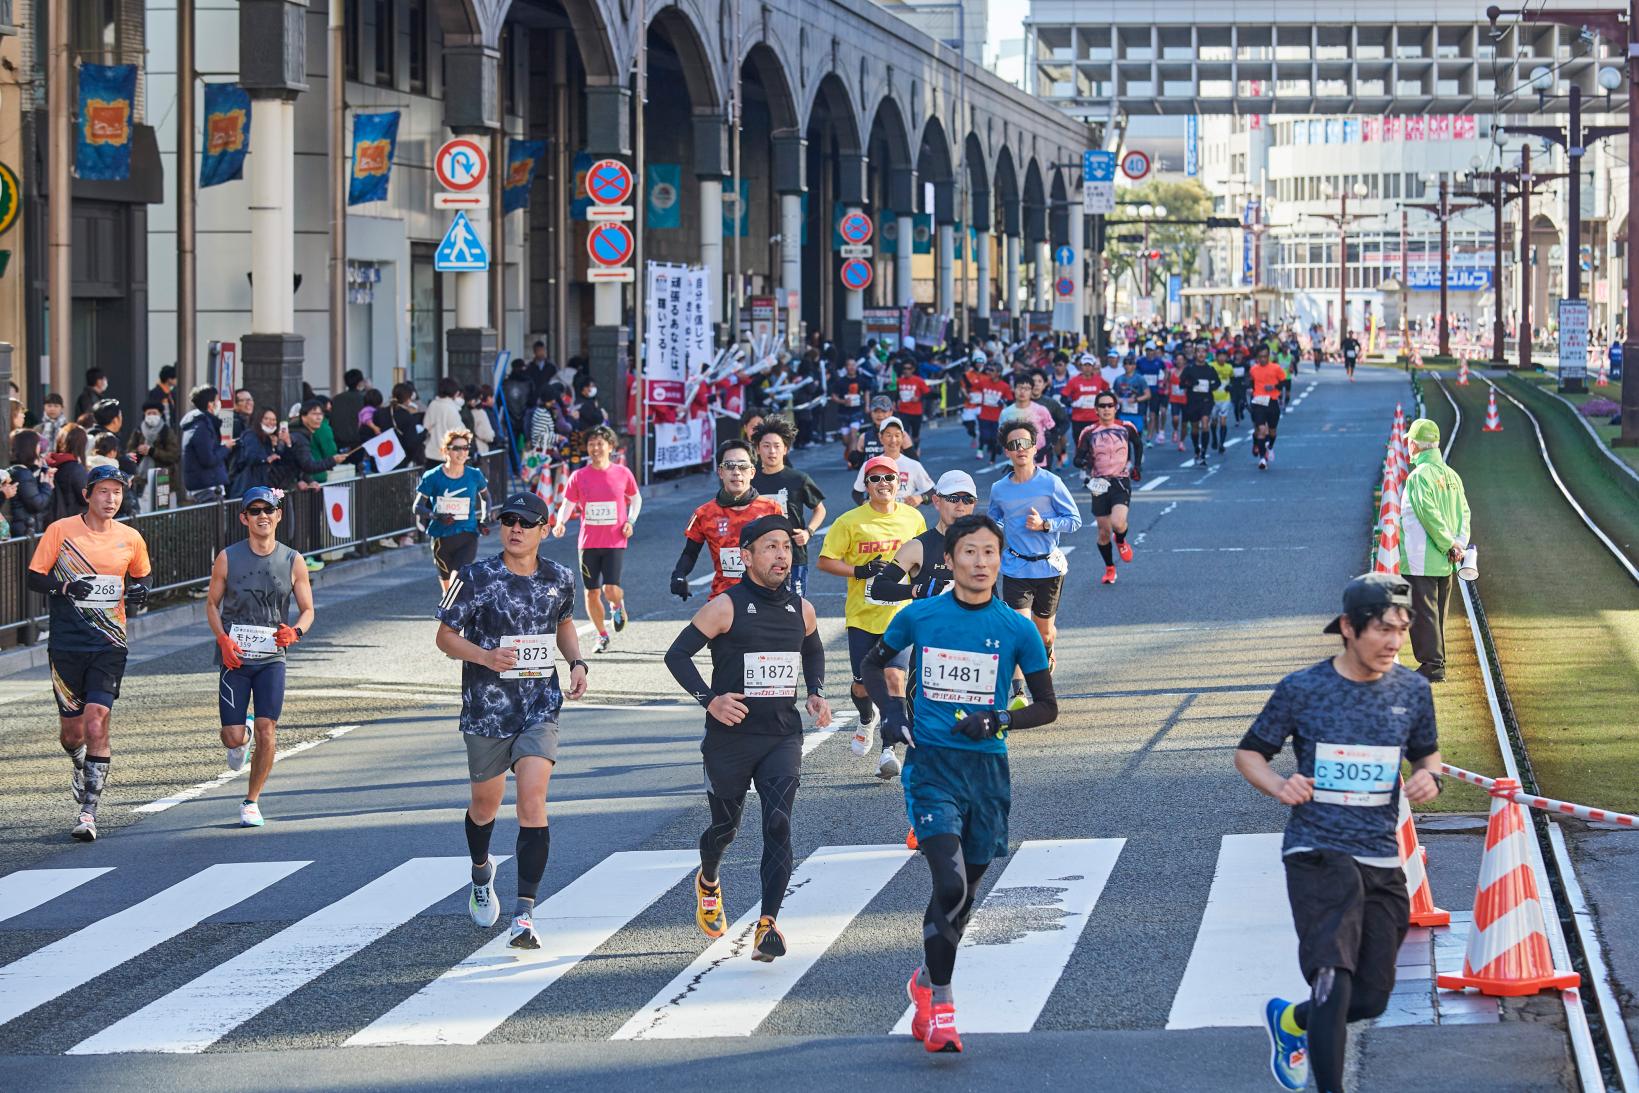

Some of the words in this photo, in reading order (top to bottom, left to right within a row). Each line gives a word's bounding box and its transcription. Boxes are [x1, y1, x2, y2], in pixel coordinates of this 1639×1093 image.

[1128, 159, 1145, 172] 40
[236, 633, 267, 643] モトケン
[746, 669, 755, 679] B
[760, 665, 793, 679] 1872
[924, 666, 932, 678] B
[939, 664, 981, 683] 1481
[1317, 765, 1328, 778] C
[1333, 763, 1384, 782] 3052
